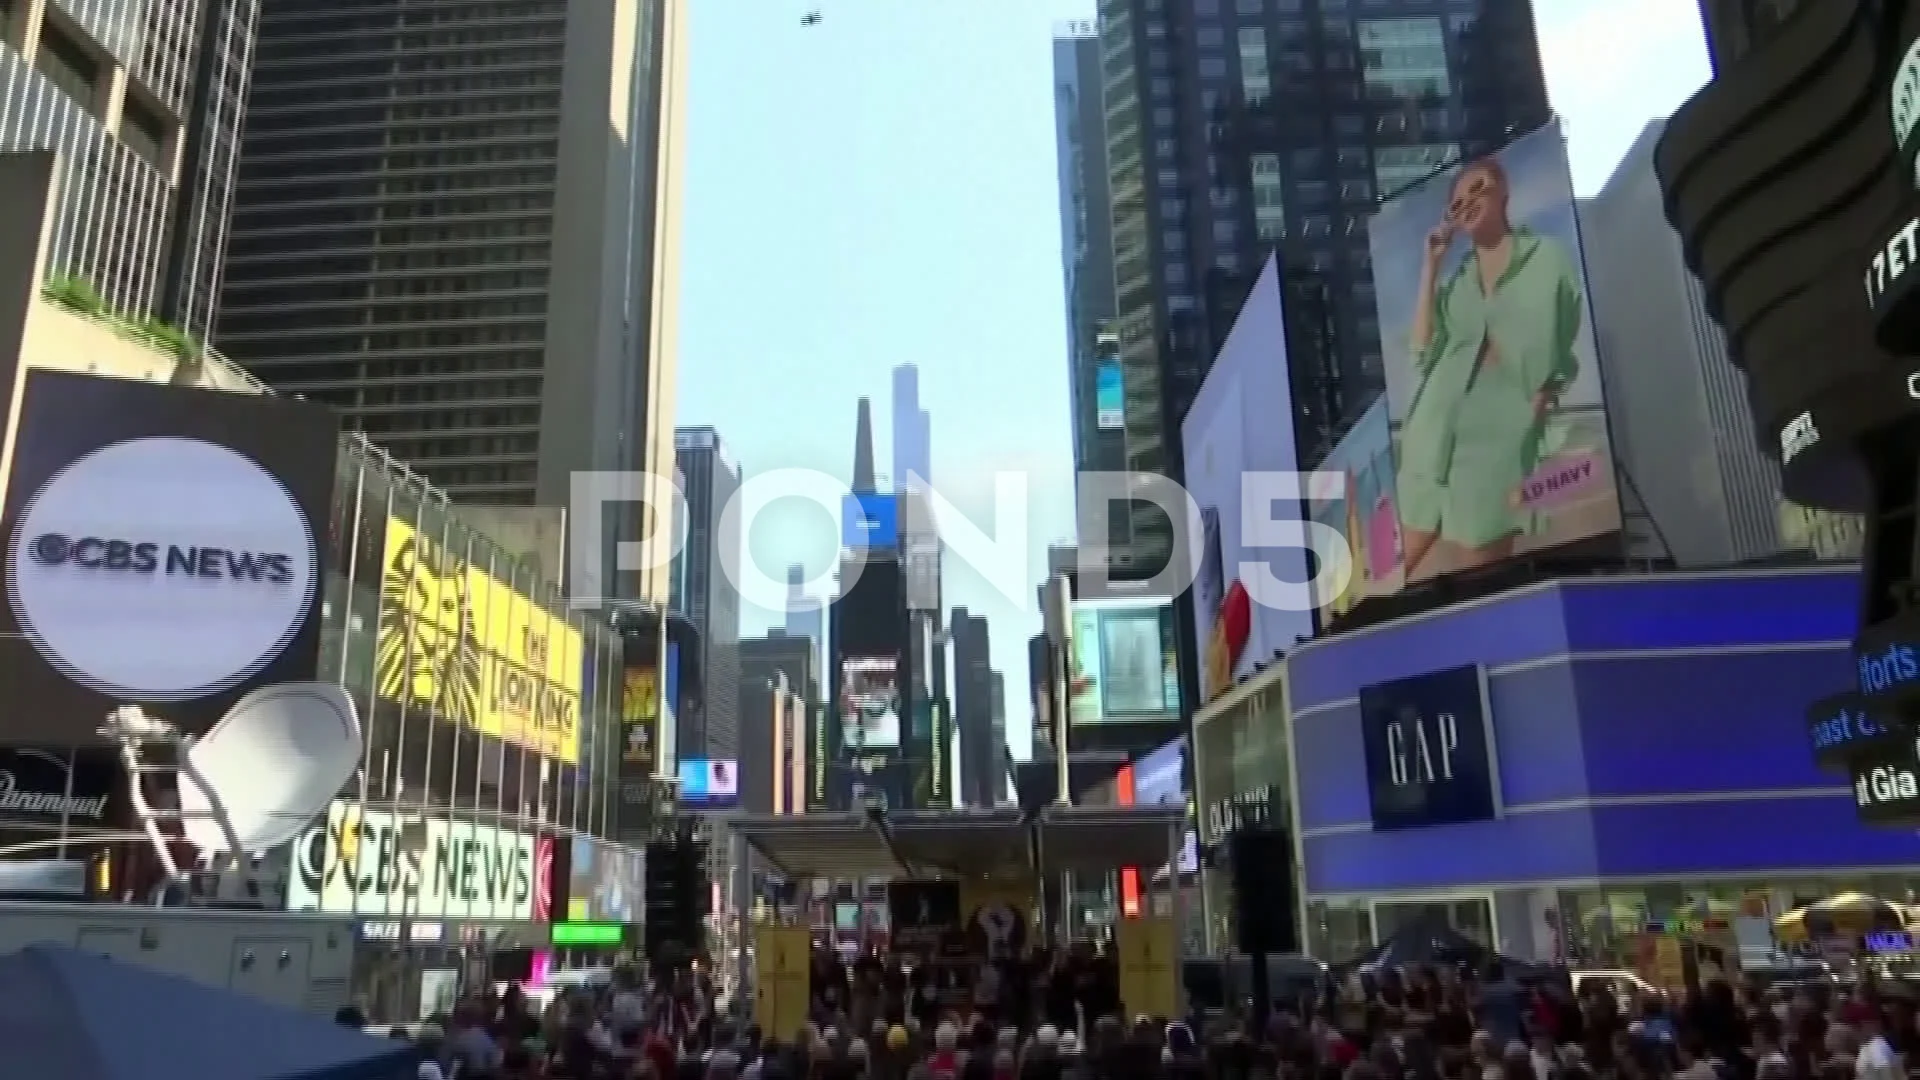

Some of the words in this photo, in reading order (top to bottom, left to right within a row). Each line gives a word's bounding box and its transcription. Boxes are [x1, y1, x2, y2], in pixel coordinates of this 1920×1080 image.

[1546, 459, 1592, 491] NAVY
[72, 536, 159, 574] CBS
[166, 544, 296, 583] NEWS
[1387, 712, 1457, 786] GAP
[433, 834, 530, 905] NEWS
